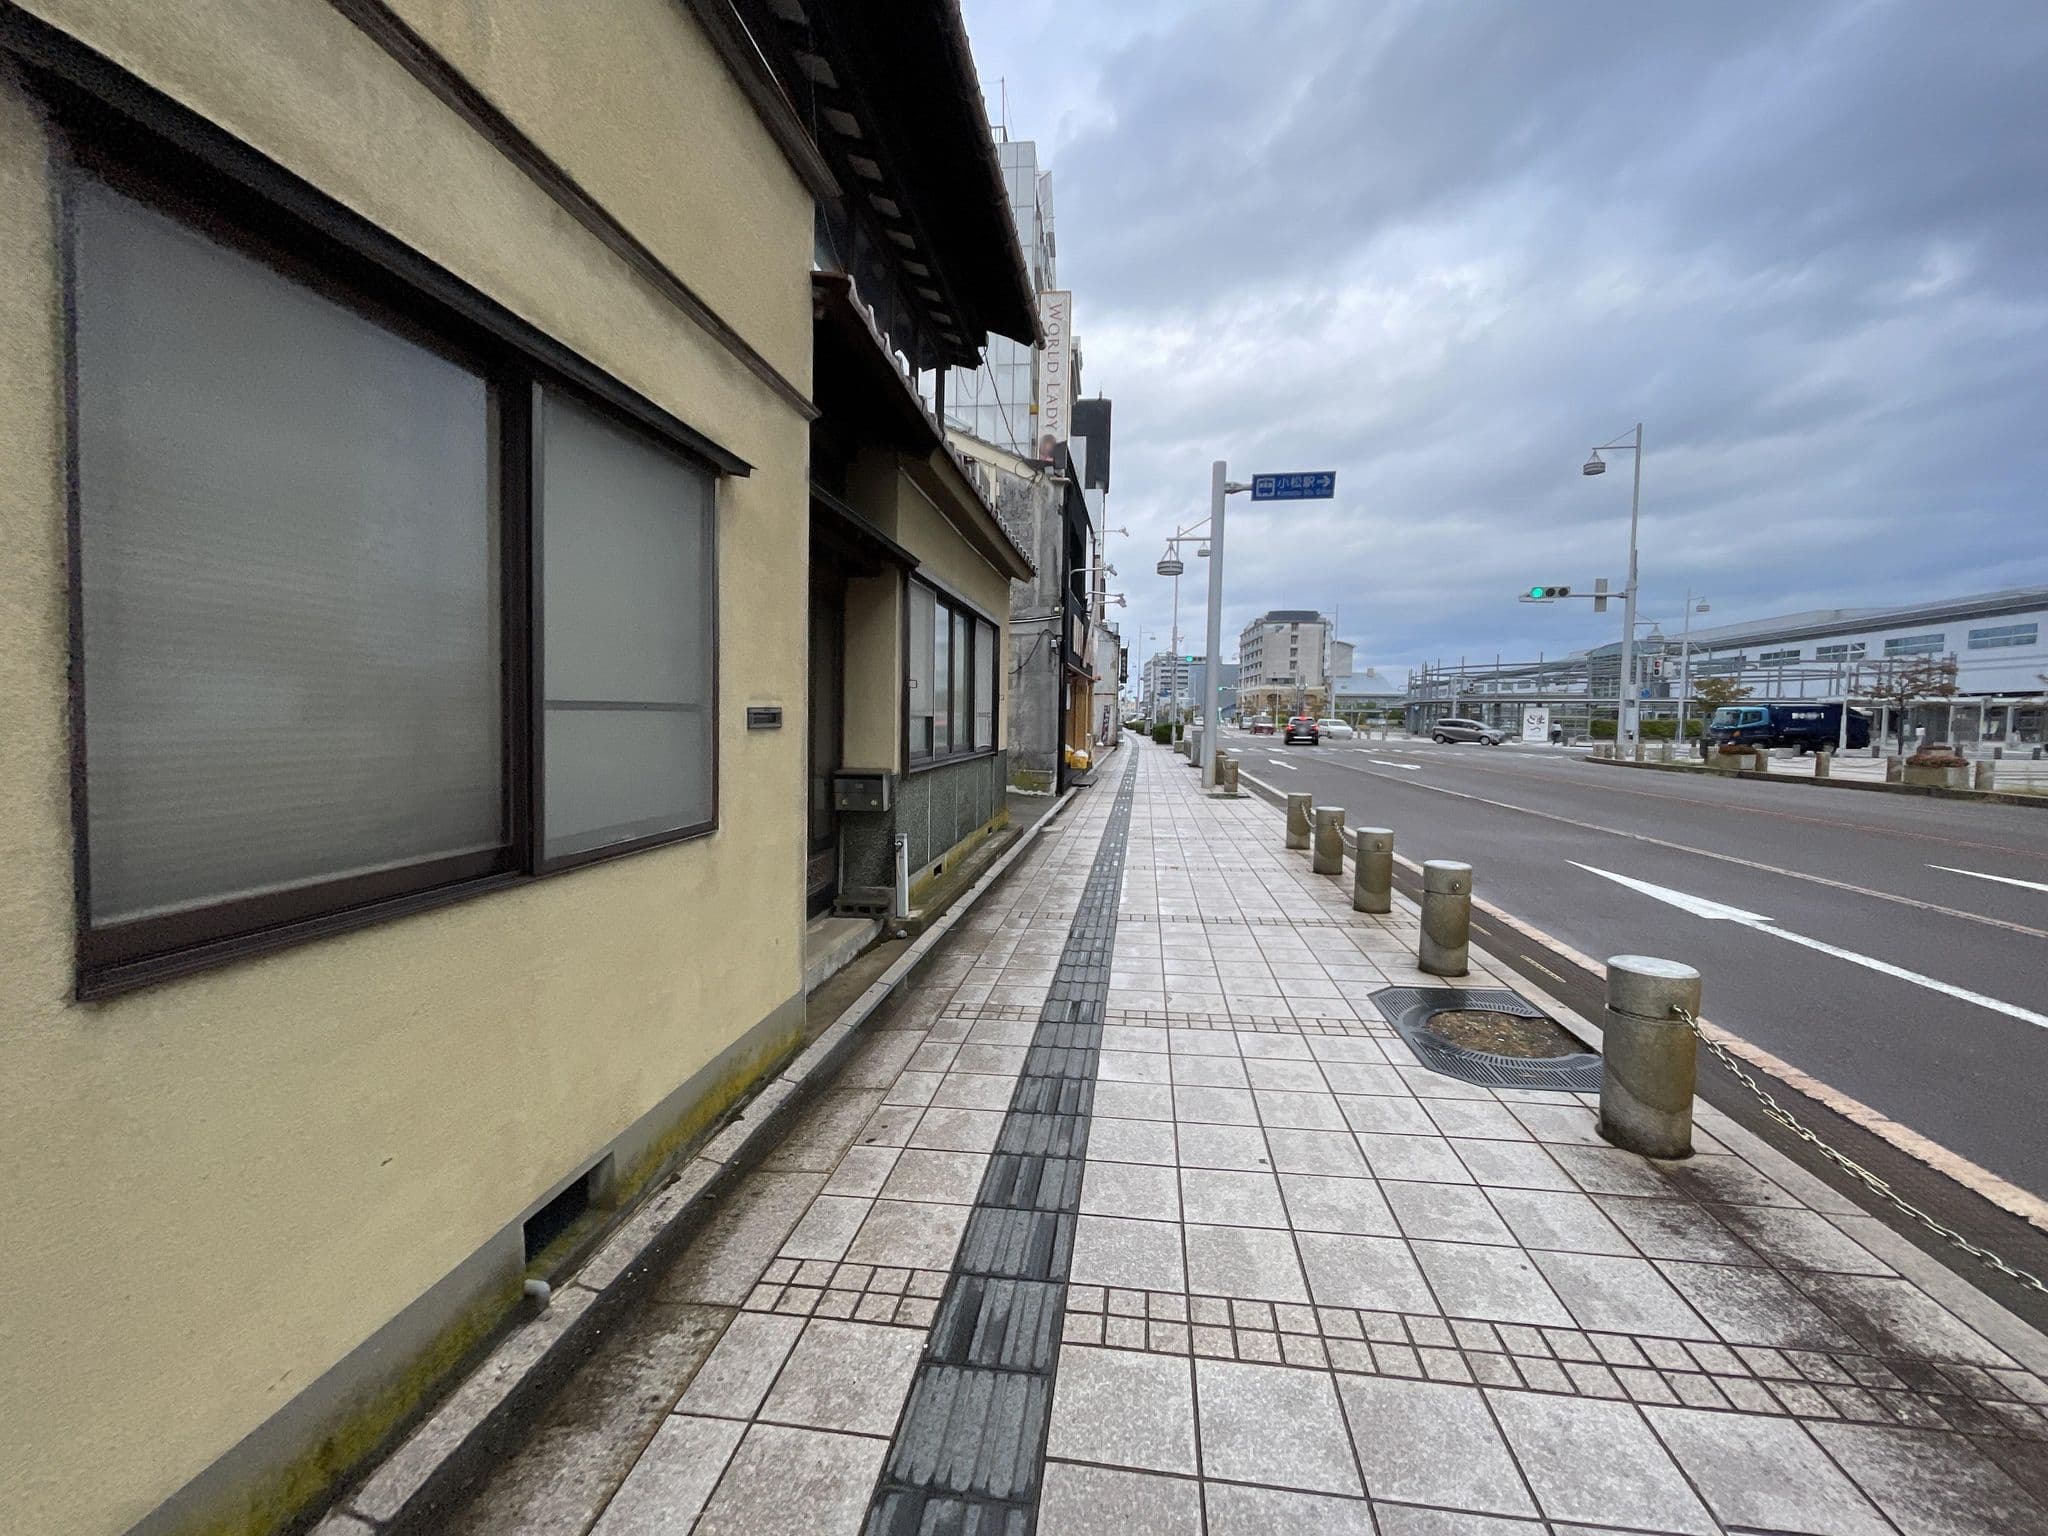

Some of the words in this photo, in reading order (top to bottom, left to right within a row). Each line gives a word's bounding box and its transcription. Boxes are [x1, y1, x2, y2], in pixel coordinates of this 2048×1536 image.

[1047, 303, 1063, 374] WORLD
[1045, 383, 1060, 433] LADY
[1276, 475, 1315, 488] 小松駅
